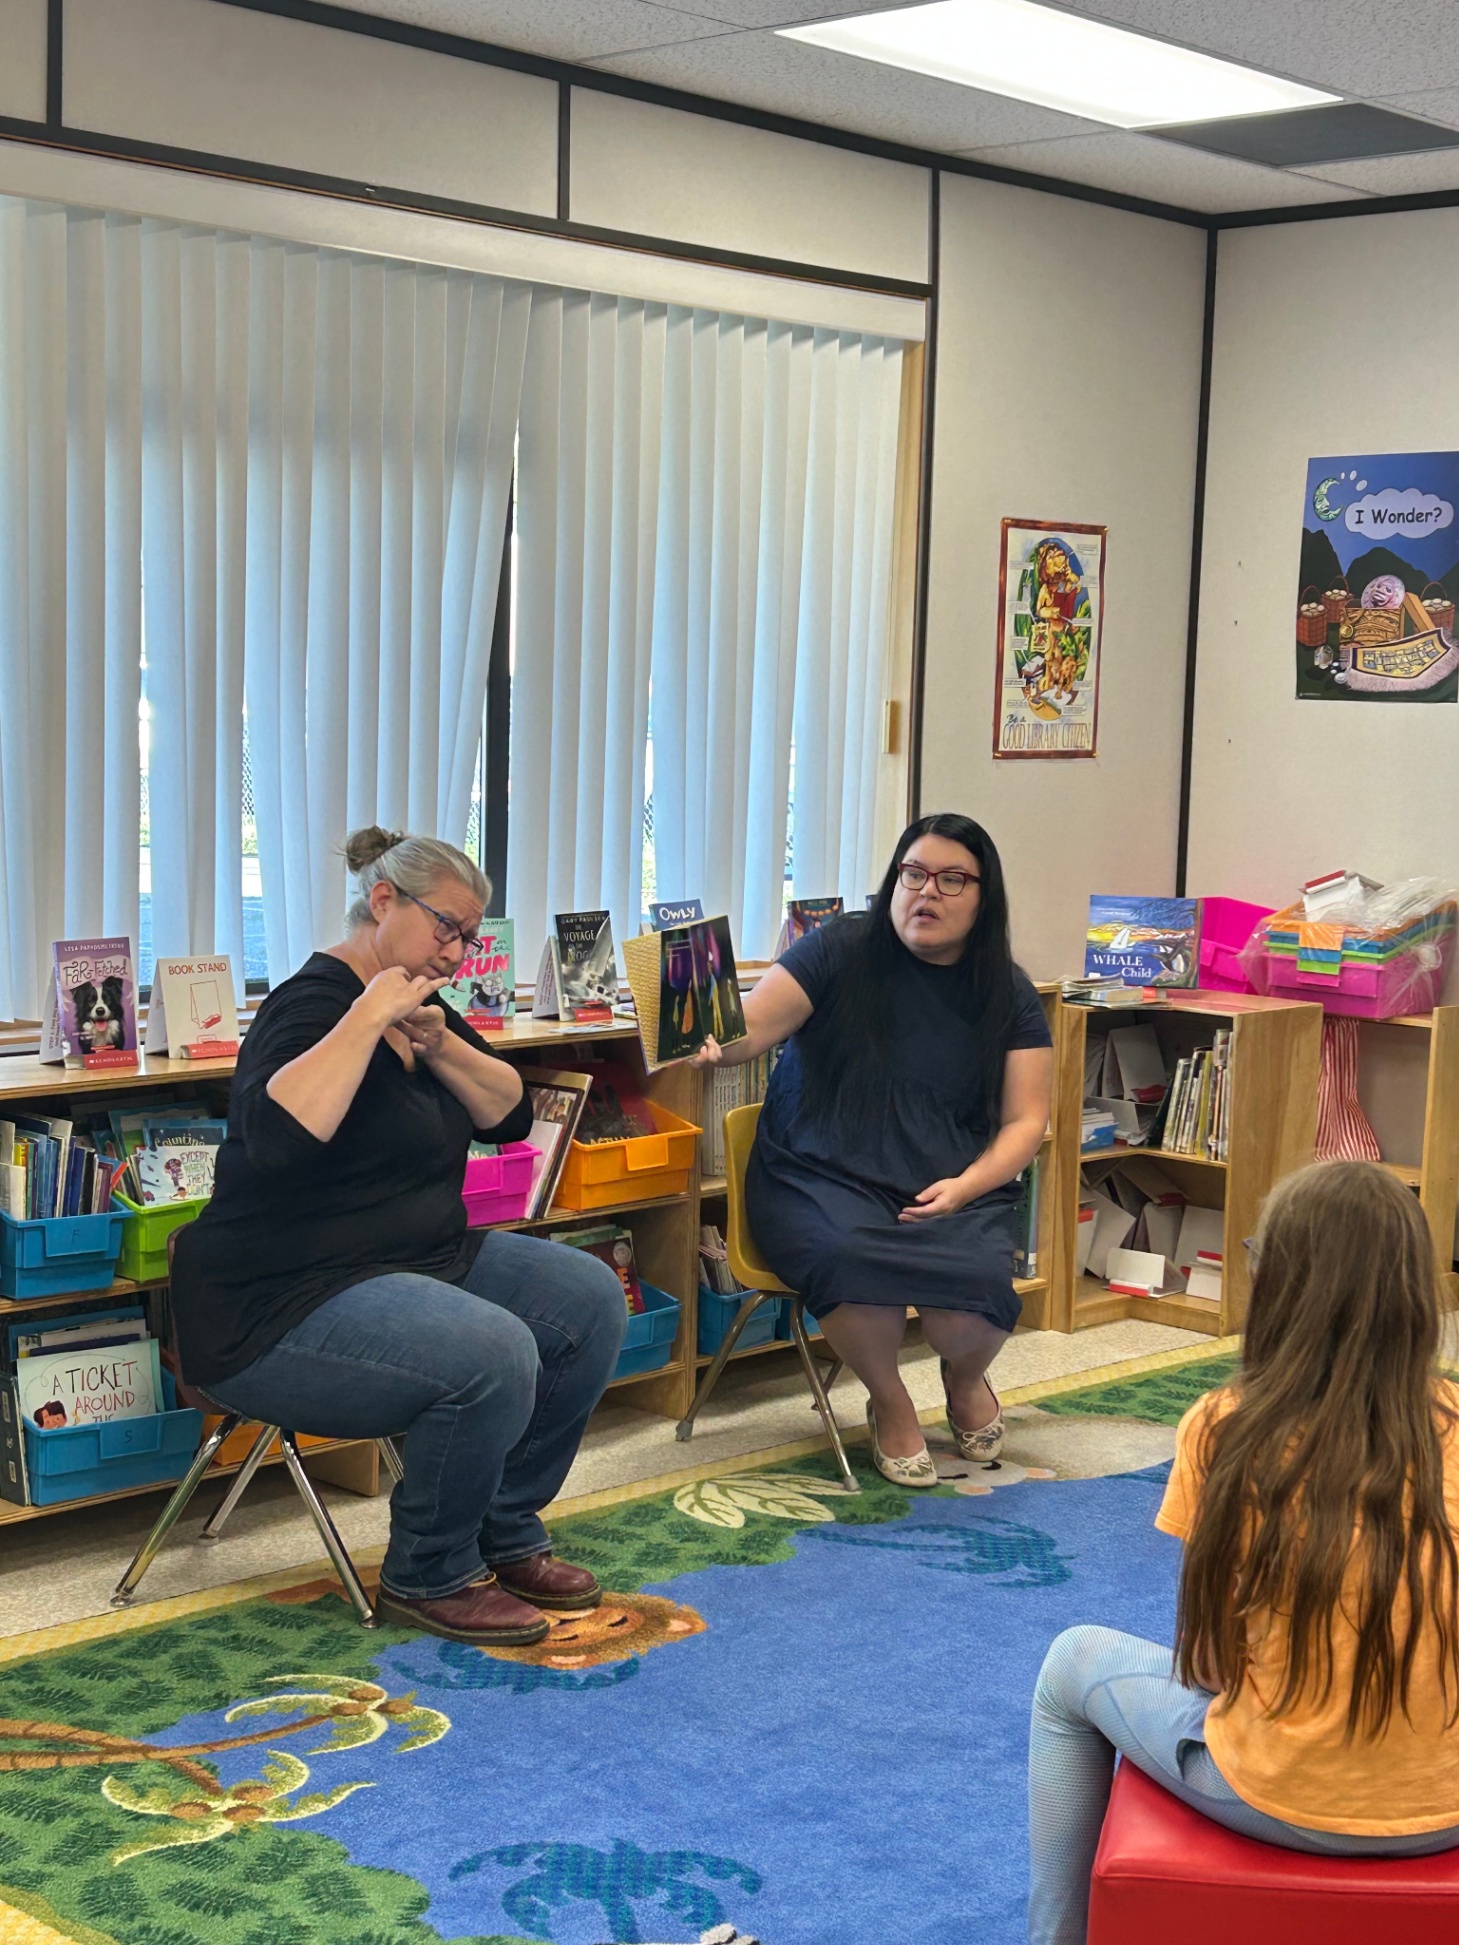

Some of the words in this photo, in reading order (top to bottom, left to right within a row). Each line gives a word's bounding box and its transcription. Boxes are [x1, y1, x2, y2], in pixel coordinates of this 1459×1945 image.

[1355, 510, 1364, 524] I
[1371, 507, 1443, 524] Wonder?
[563, 929, 595, 942] VOYAGE
[455, 953, 510, 979] RUN
[1093, 954, 1143, 966] WHALE
[169, 964, 195, 975] BOOK
[197, 962, 227, 974] STAND
[1121, 967, 1152, 978] Child
[53, 1374, 64, 1396] A
[65, 1361, 138, 1393] TICKET
[75, 1390, 135, 1416] AROUND
